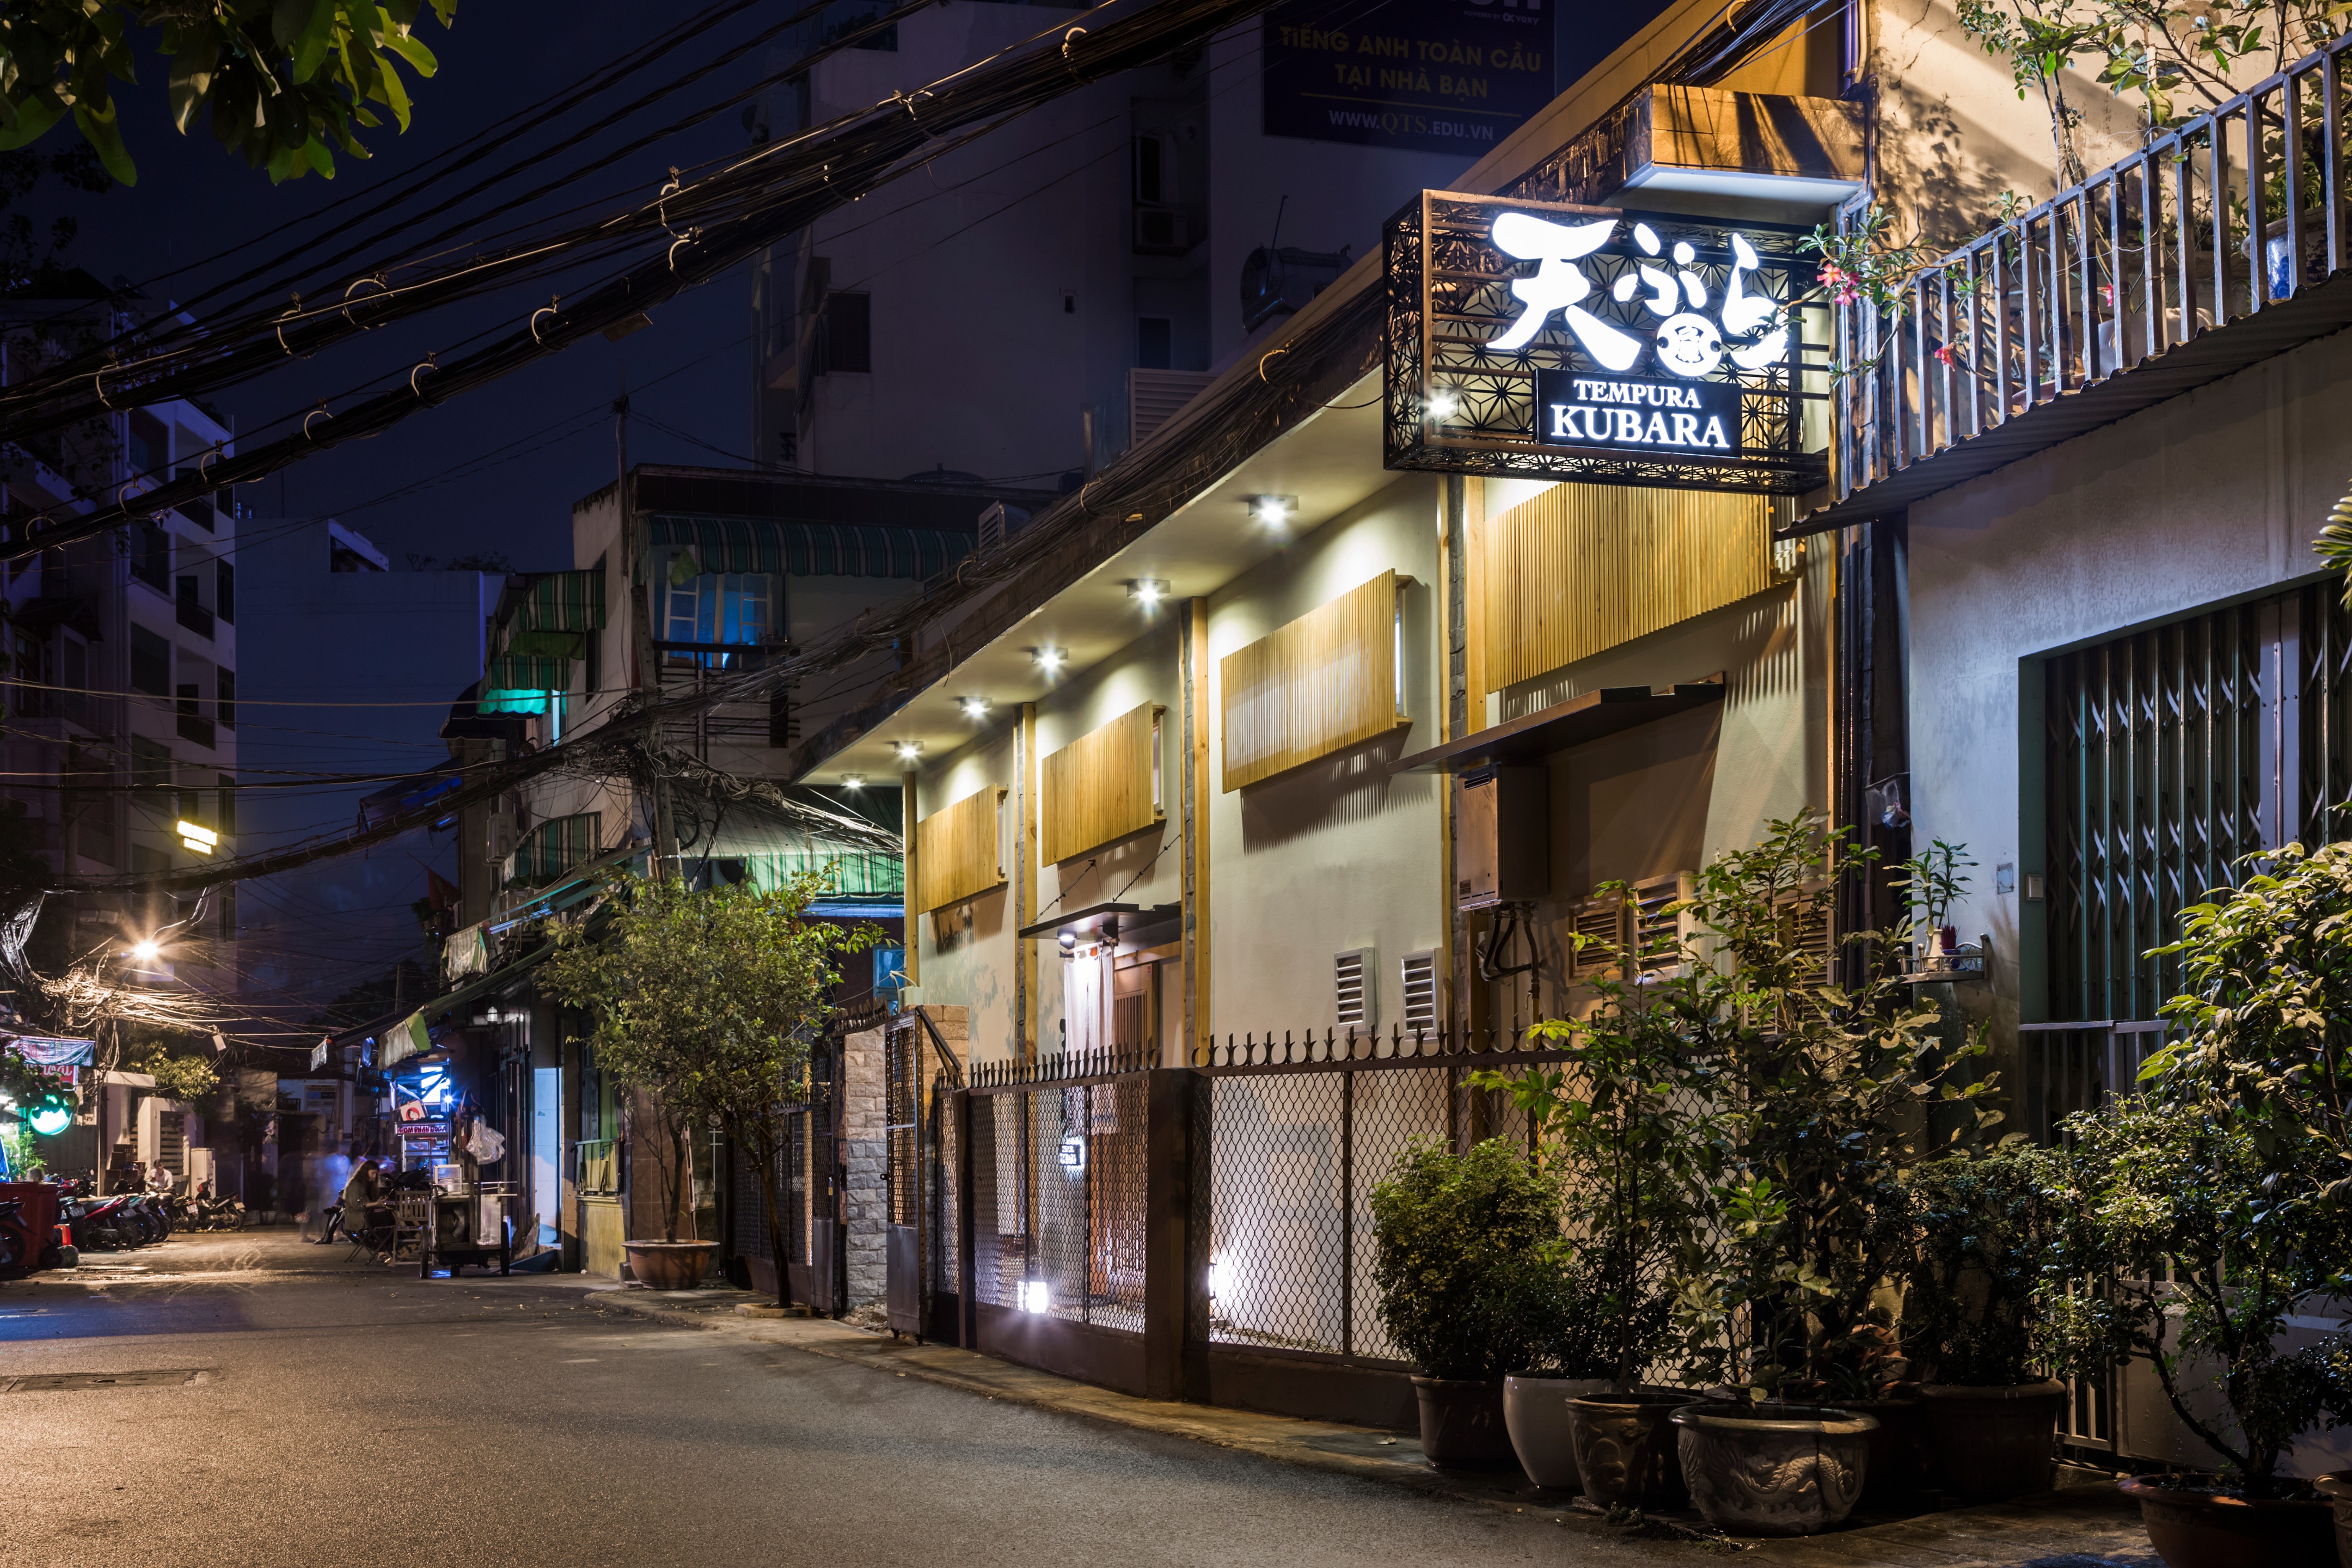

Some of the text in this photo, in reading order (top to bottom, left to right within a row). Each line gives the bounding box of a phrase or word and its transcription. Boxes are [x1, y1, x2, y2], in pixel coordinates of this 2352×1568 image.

[1463, 10, 1492, 19] POWERED
[1280, 21, 1541, 72] TIẾNG ANH TOÀN CẦU
[1335, 64, 1487, 102] TẠI NHÀ BẠN
[1329, 110, 1494, 140] WWW.QTS.EDU.VN
[1486, 212, 1788, 377] 天ぷら
[1573, 379, 1702, 409] TEMPURA
[1550, 405, 1730, 448] KUBARA
